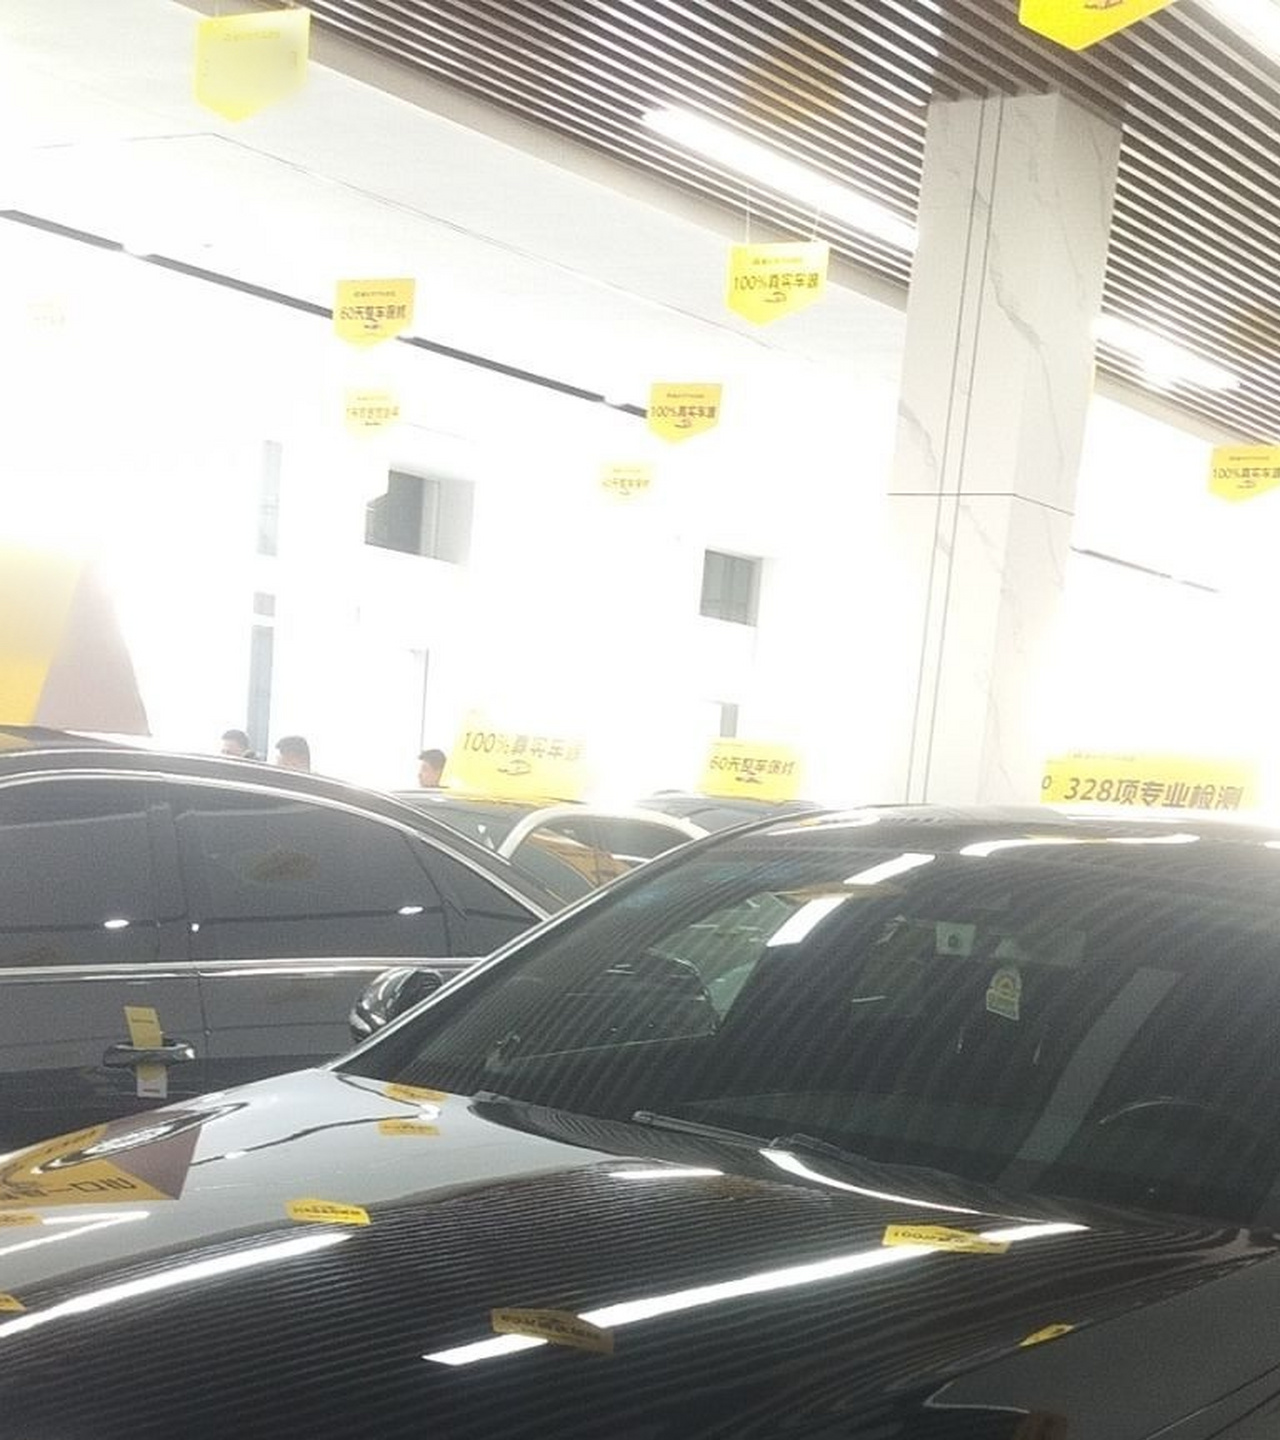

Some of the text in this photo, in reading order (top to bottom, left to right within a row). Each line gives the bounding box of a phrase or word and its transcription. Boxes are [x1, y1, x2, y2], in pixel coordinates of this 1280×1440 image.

[1063, 776, 1245, 810] 328项专业检测
